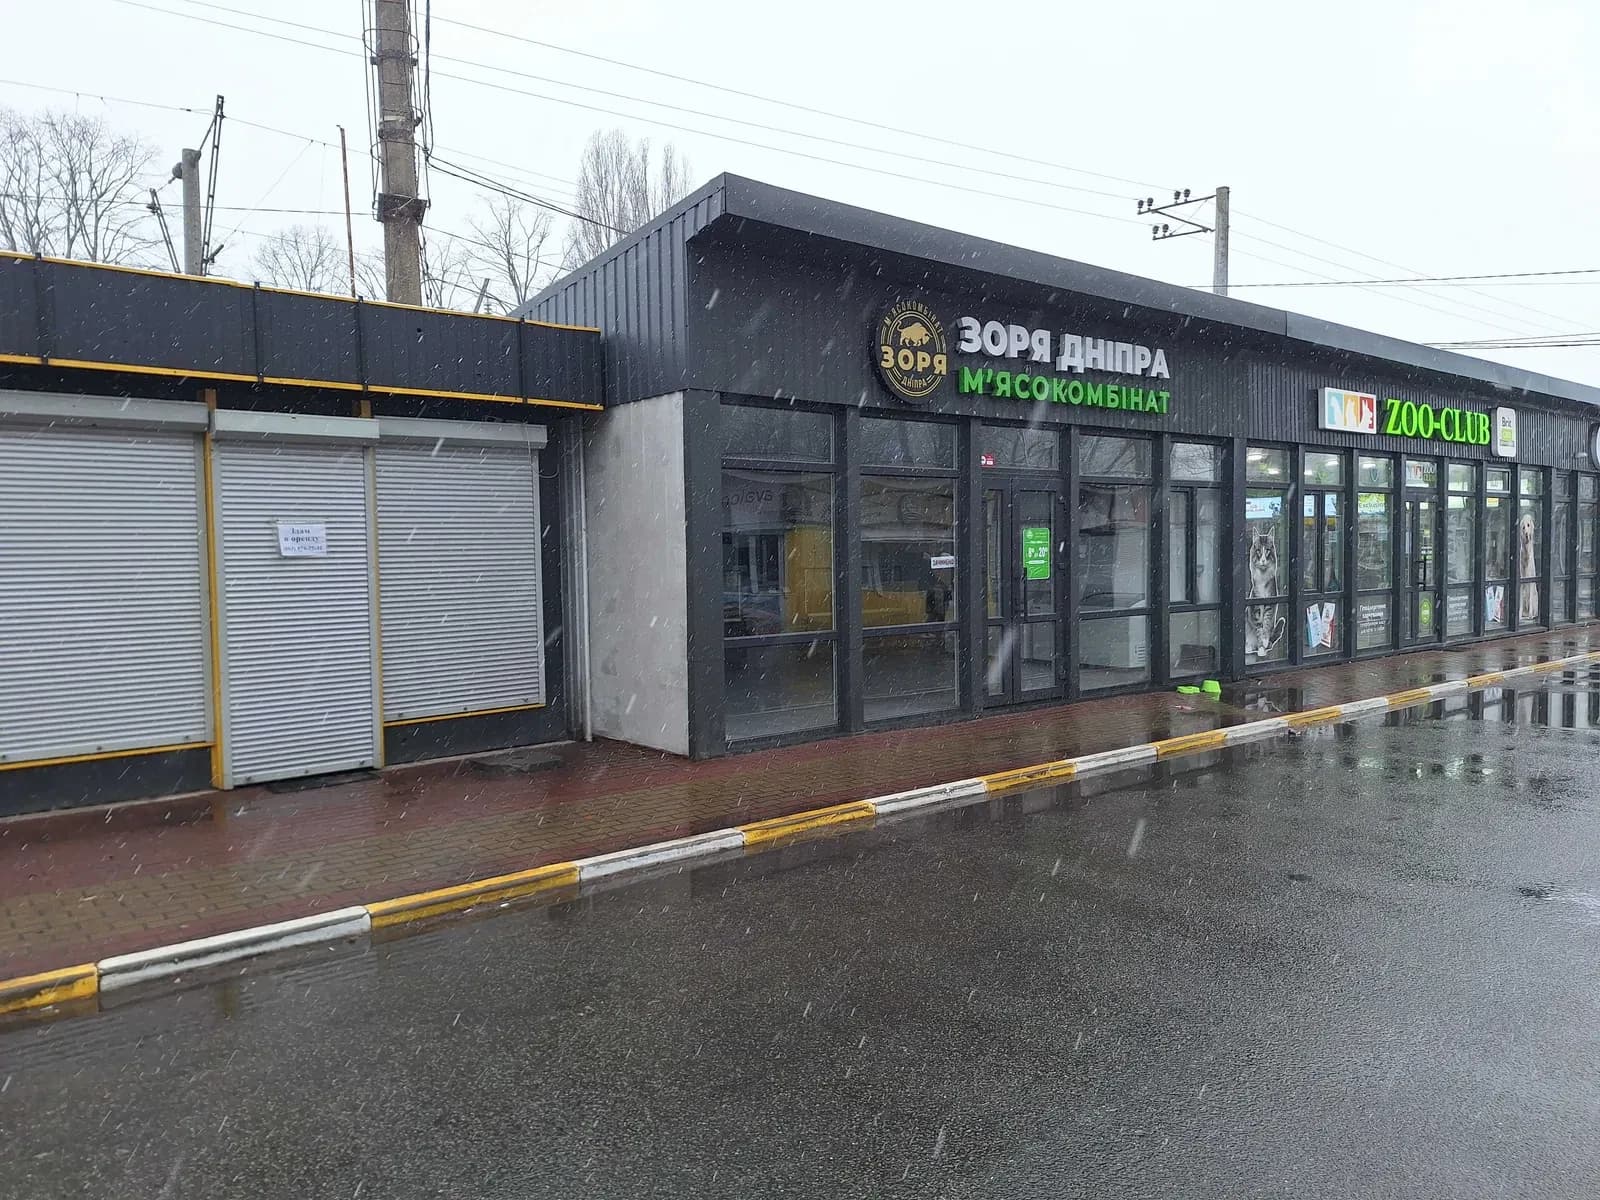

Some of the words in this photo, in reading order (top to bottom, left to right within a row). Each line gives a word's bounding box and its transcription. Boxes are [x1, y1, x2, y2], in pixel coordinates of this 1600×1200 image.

[881, 345, 947, 376] ЗОРЯ
[959, 316, 1051, 362] ЗОРЯ
[1055, 333, 1170, 379] ДНІПРА
[901, 375, 928, 389] ДНІПРА
[960, 366, 1170, 414] М'ЯСОКОМБІНАТ
[1386, 398, 1490, 445] ZOO-CLUB
